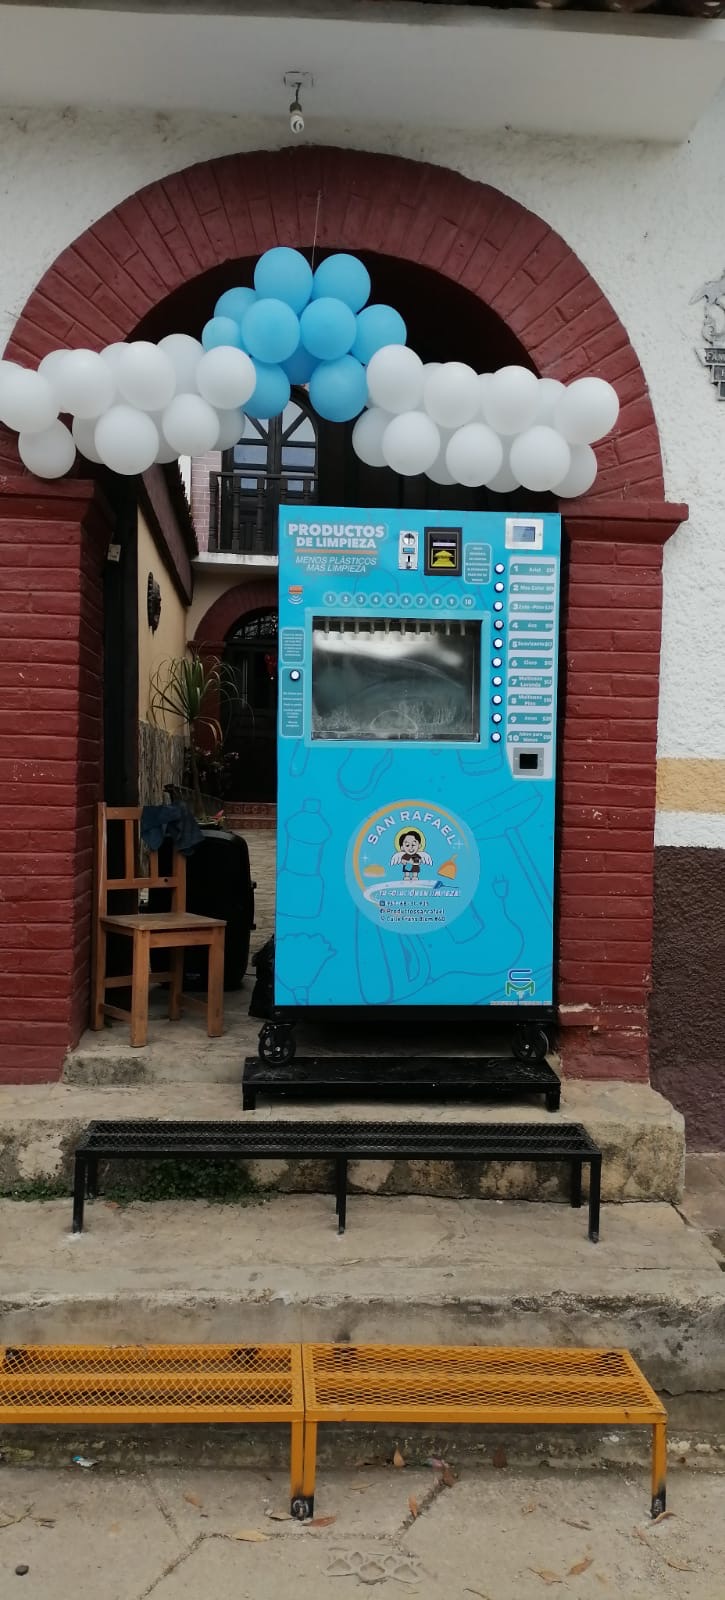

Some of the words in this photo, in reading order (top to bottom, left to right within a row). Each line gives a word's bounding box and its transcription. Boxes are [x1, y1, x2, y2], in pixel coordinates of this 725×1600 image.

[288, 523, 385, 538] PRODUCTOS
[296, 537, 313, 547] DE
[315, 537, 377, 548] LIMPIEZA
[296, 556, 327, 564] MENOS
[329, 556, 377, 566] PLÁSTICOS
[327, 565, 367, 573] LIMPIEZA
[512, 584, 519, 592] 2
[368, 816, 396, 845] SAN
[400, 811, 457, 845] RAFAEL
